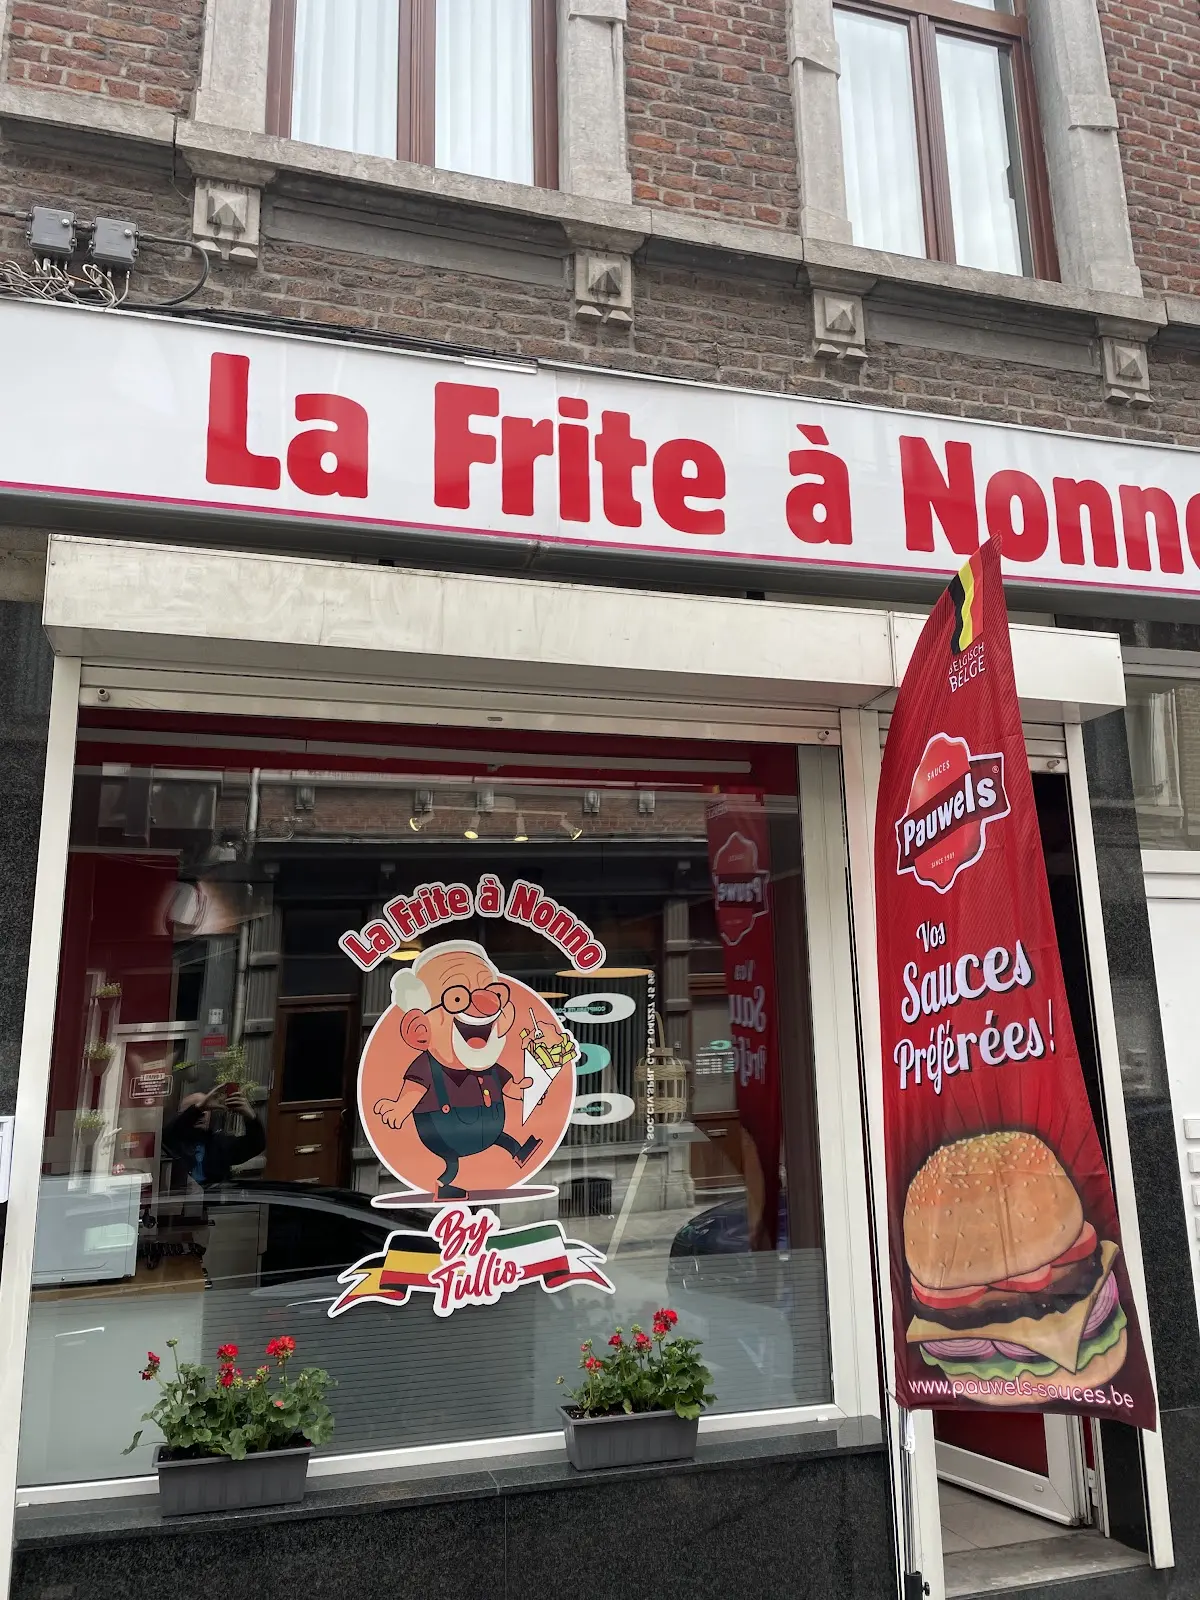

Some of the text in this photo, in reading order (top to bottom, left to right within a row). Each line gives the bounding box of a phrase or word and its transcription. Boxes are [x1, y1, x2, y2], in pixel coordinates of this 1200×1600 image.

[206, 352, 1200, 576] La Frite à Nonn
[949, 655, 985, 693] BELGE
[927, 760, 950, 782] SAUCES
[903, 772, 997, 857] Pauwels
[344, 878, 602, 971] La Frite à Nonno
[916, 920, 946, 953] Vos
[901, 939, 1033, 1024] Sauces
[434, 1209, 494, 1261] By
[431, 1251, 522, 1310] Tullio
[907, 1376, 1135, 1409] www.pauwels-sauces.be
